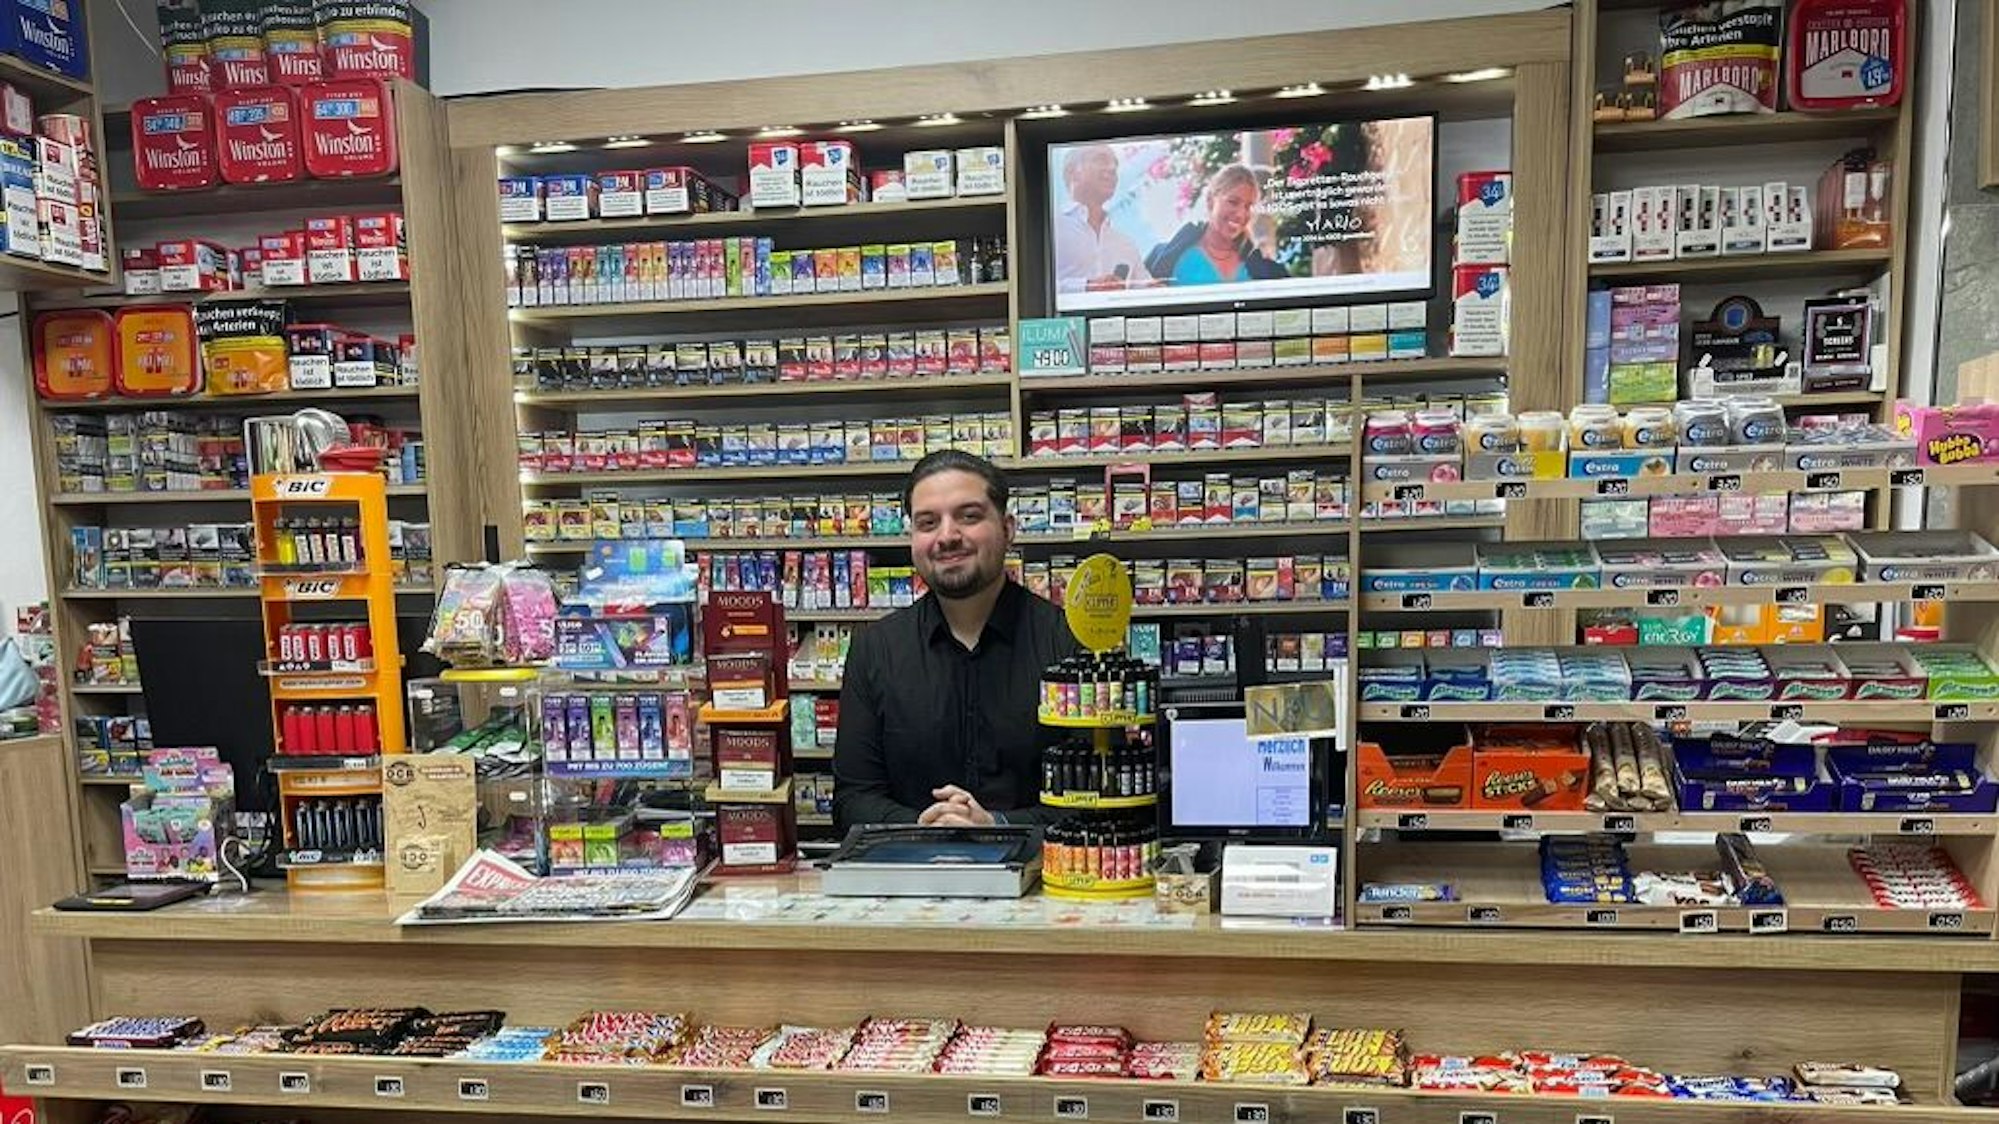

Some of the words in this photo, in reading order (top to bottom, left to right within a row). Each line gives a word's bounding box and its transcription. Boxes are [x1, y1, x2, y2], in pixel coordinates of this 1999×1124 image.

[19, 15, 70, 54] Winston
[1805, 28, 1890, 66] MARLBORO
[335, 47, 399, 72] Winston
[1679, 64, 1760, 98] MARLBORO
[229, 138, 286, 161] Winston
[315, 131, 374, 156] Winston
[145, 148, 201, 169] Winston
[1688, 423, 1724, 440] extra
[1744, 422, 1783, 438] extra
[1928, 434, 1971, 456] Hubba
[1939, 443, 1981, 464] Bubba
[1585, 460, 1620, 475] extra
[1690, 456, 1728, 473] extra
[1798, 454, 1836, 471] extra
[1375, 464, 1410, 480] extra
[288, 481, 325, 493] BIC
[1740, 570, 1777, 585] extra
[1880, 565, 1918, 582] extra
[298, 582, 335, 594] BIC
[1373, 576, 1405, 590] extra
[1493, 576, 1526, 590] extra
[718, 595, 764, 609] MOODS
[455, 609, 484, 630] 50
[726, 736, 770, 748] MOODS
[386, 769, 415, 780] OCB
